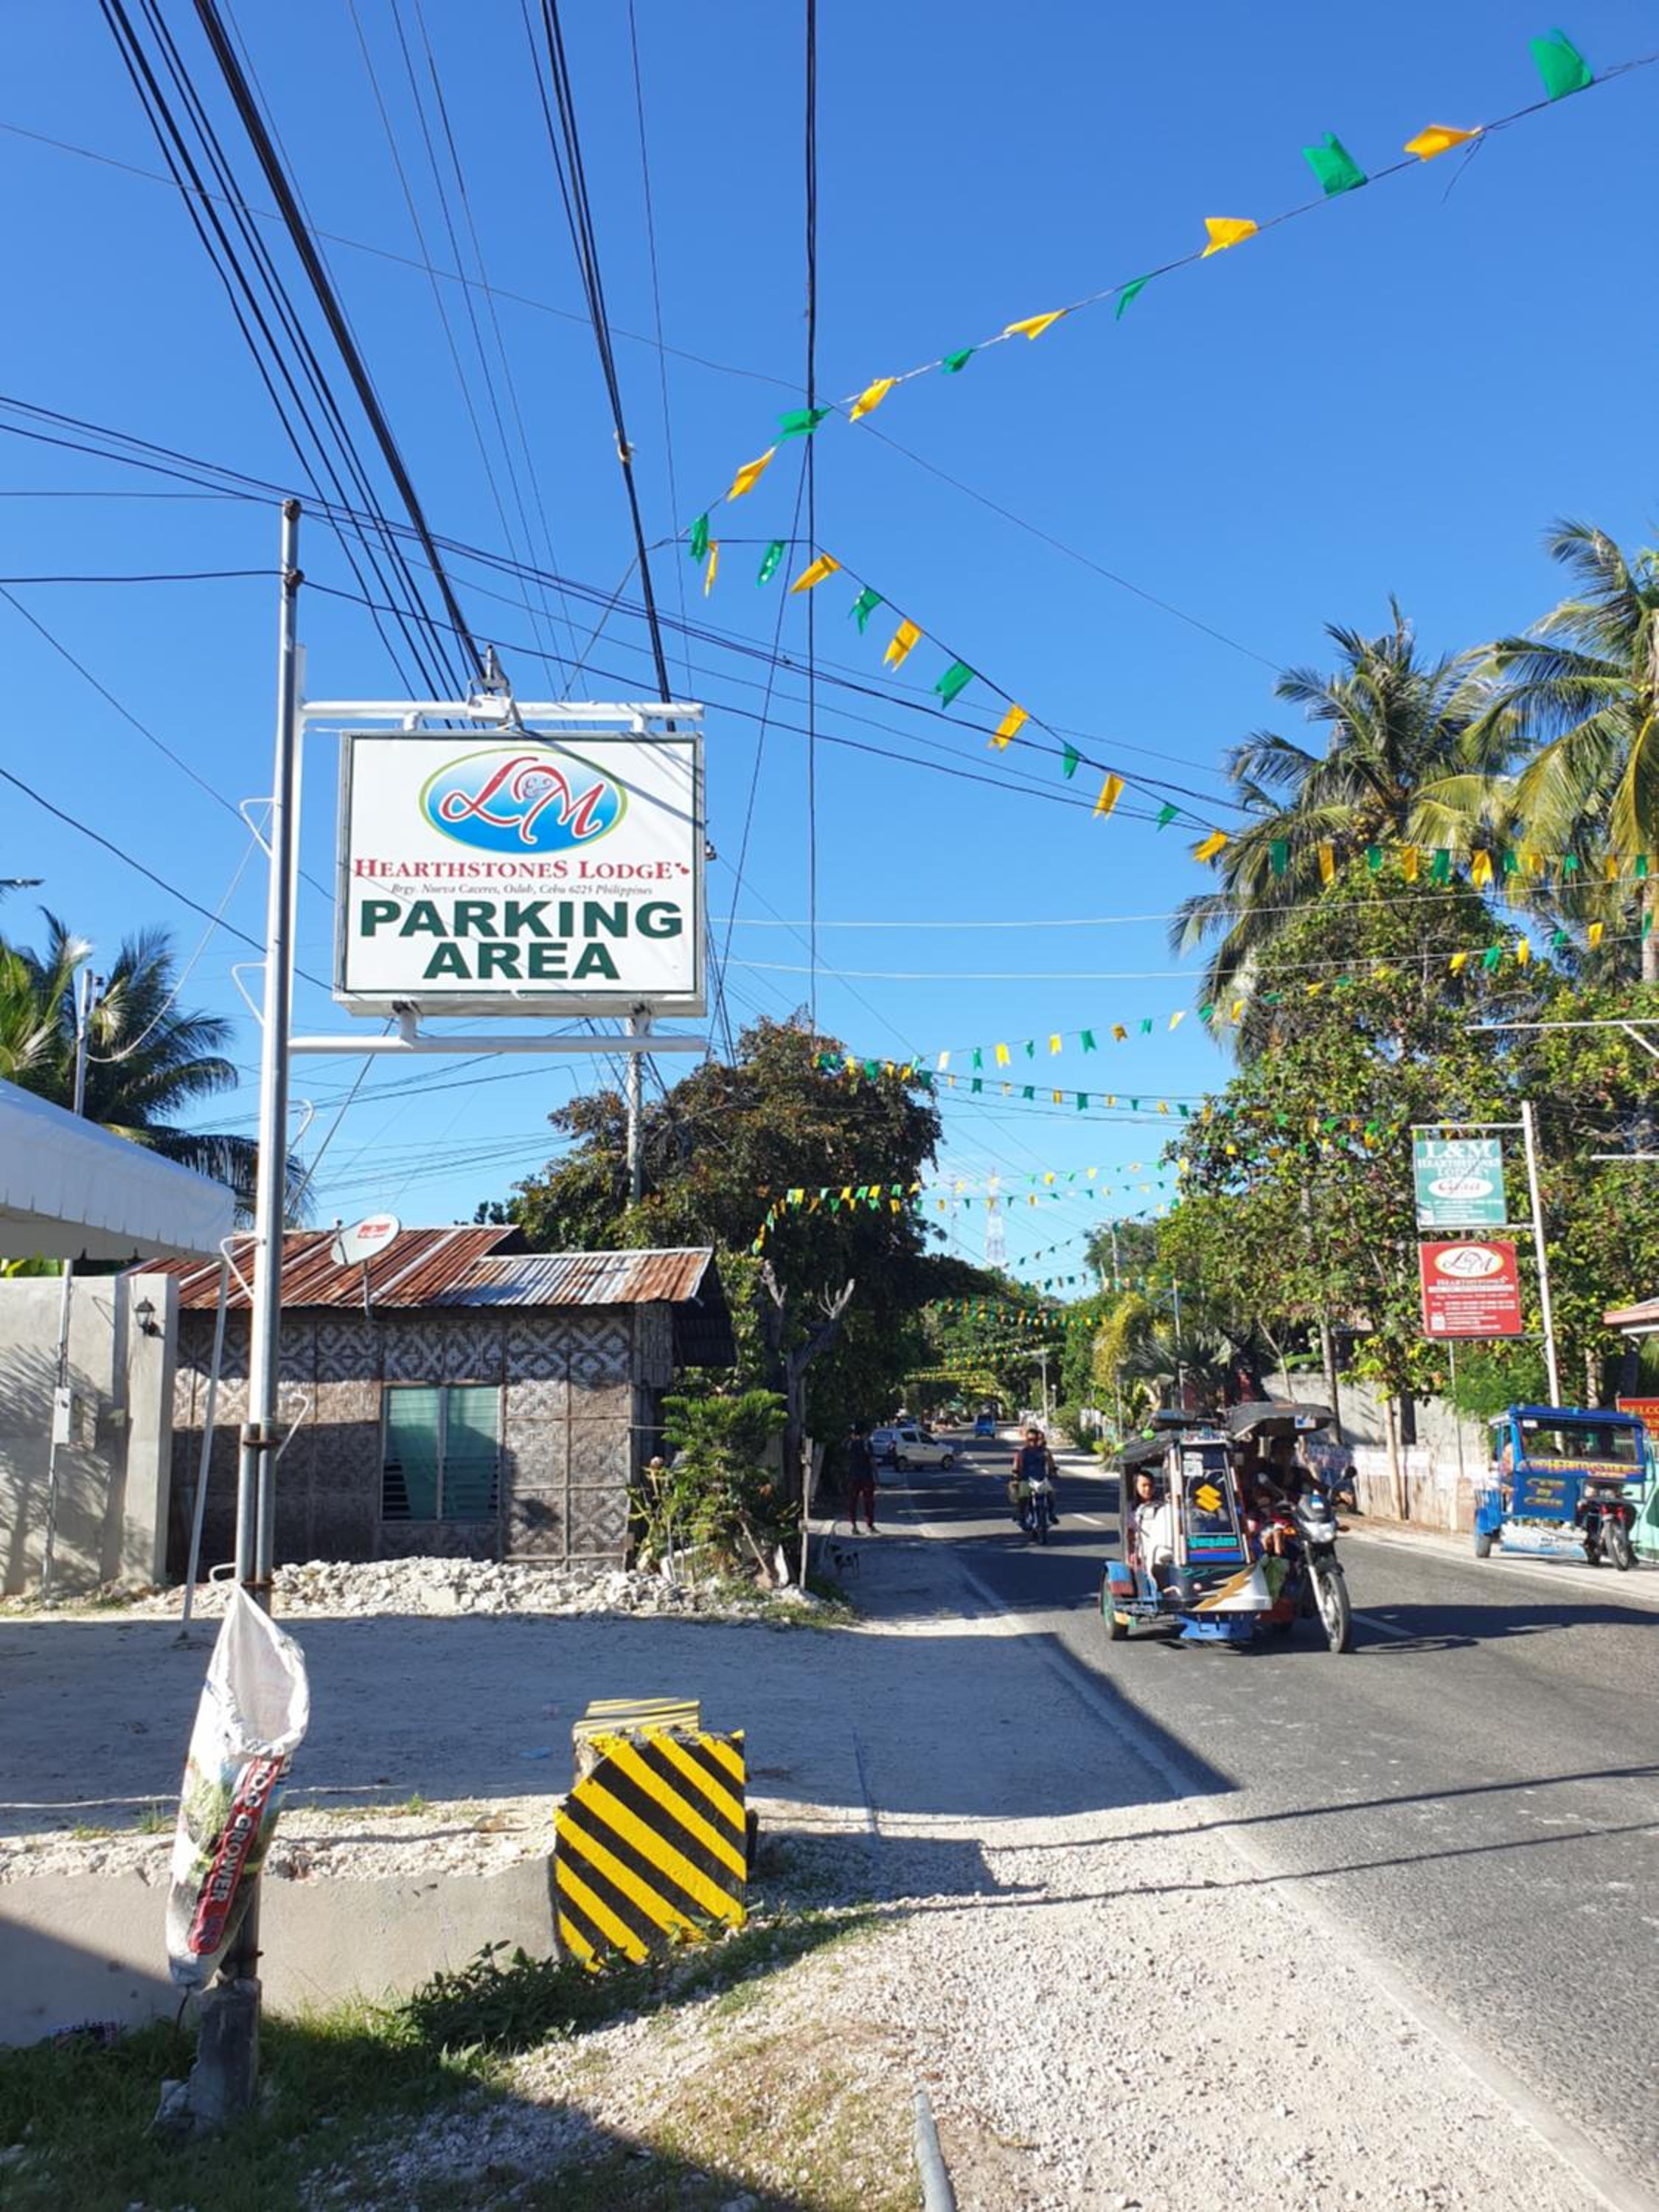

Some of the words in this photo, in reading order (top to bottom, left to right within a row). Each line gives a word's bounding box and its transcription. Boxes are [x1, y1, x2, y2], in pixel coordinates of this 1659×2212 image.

[354, 858, 568, 880] HEARTHSTONES
[579, 860, 672, 880] LODGE
[360, 900, 683, 939] PARKING
[422, 942, 620, 979] AREA
[212, 1813, 252, 1902] GROWER
